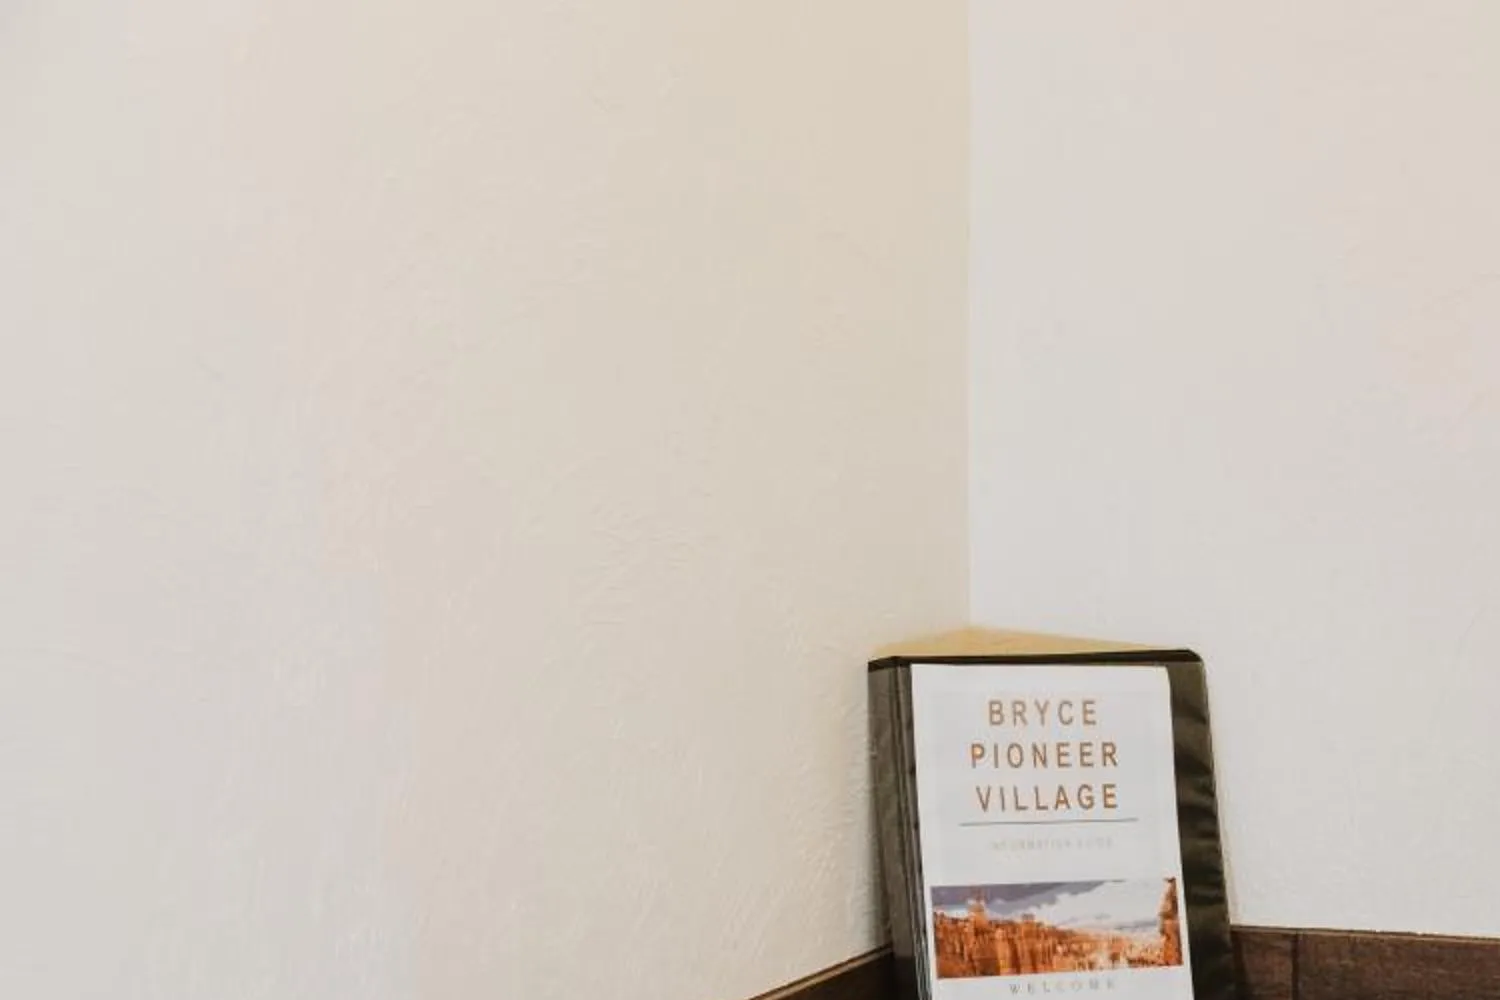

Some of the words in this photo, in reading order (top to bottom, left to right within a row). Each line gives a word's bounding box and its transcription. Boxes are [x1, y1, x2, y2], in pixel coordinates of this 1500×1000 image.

[988, 699, 1097, 727] BRYCE
[970, 741, 1118, 769] PIONEER
[975, 783, 1118, 813] VILLAGE
[1008, 977, 1116, 996] WELCOME
